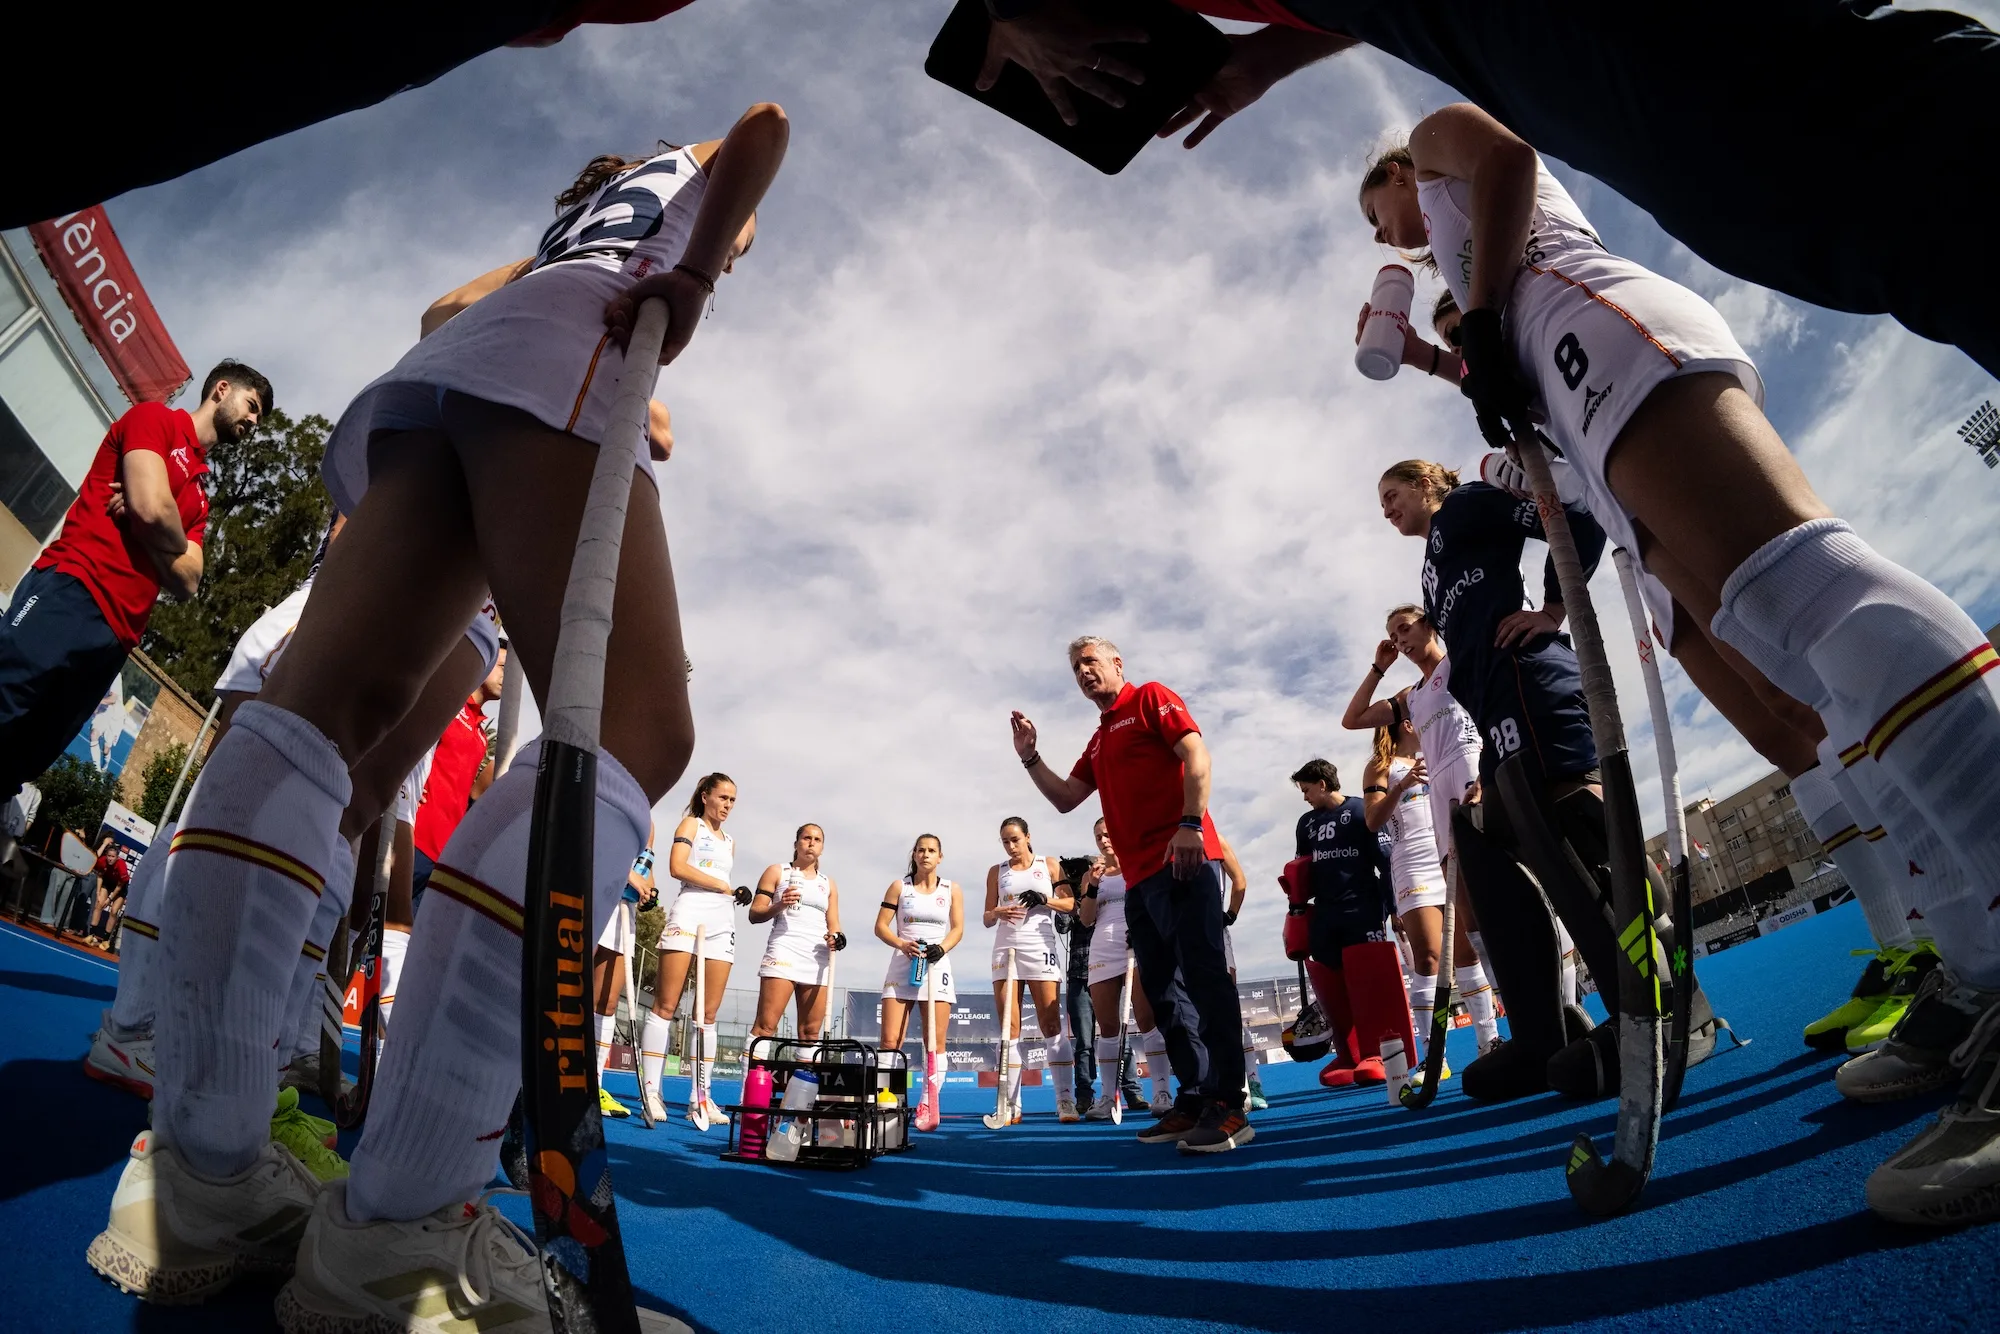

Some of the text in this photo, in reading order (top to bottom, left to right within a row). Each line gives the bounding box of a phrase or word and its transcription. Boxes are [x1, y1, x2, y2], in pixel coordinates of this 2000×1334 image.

[1554, 332, 1589, 392] 8
[1582, 381, 1614, 438] MERCURY
[11, 595, 39, 627] ESHOCKEY
[1489, 717, 1521, 760] 28
[1317, 820, 1337, 842] 26
[1779, 907, 1808, 923] ODISHA
[543, 890, 588, 1095] ritual
[942, 972, 949, 986] 6
[771, 1068, 846, 1087] KITA
